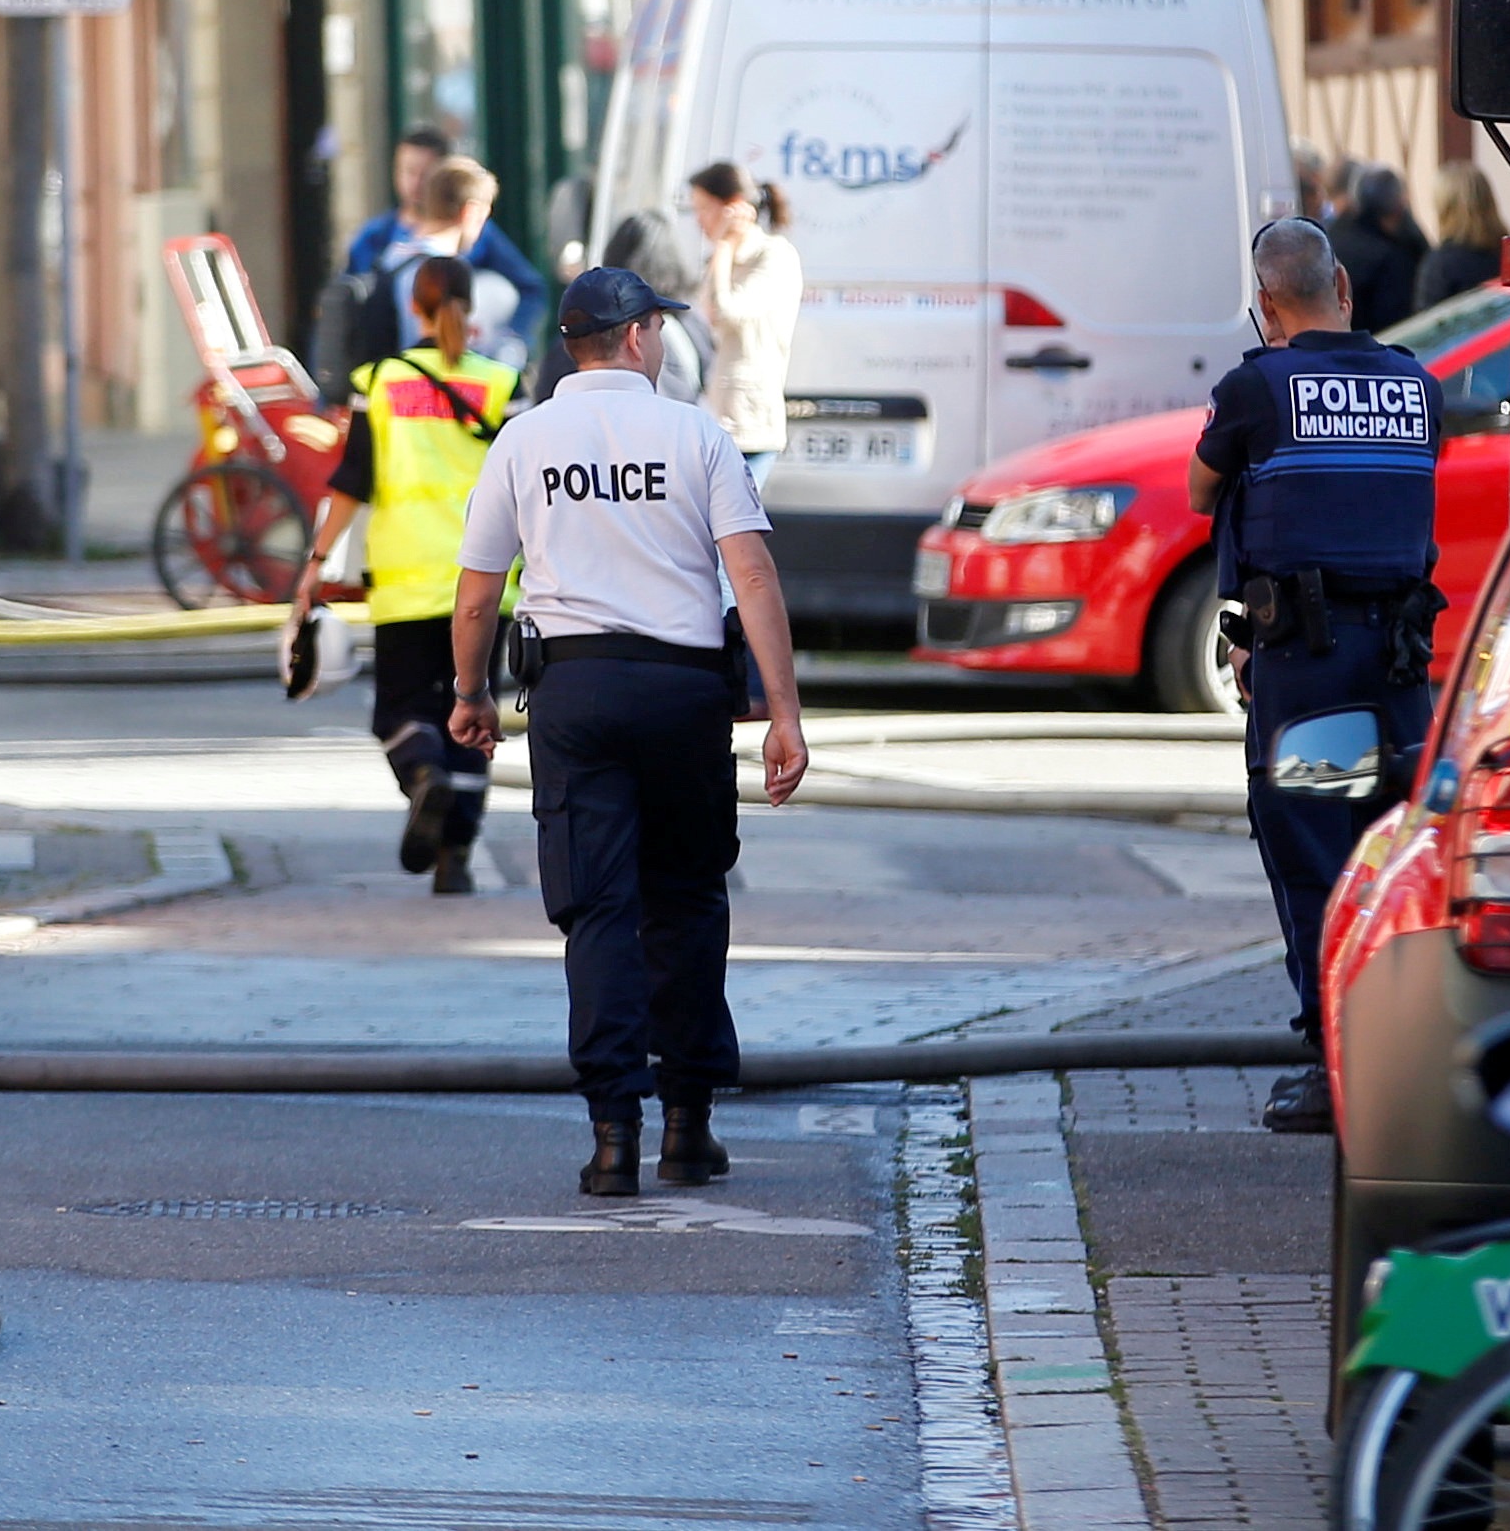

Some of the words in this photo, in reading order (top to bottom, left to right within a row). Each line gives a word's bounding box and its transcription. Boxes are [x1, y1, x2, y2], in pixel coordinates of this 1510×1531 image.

[1297, 379, 1423, 415] POLICE
[1300, 415, 1425, 439] MUNICIPALE
[542, 462, 667, 507] POLICE
